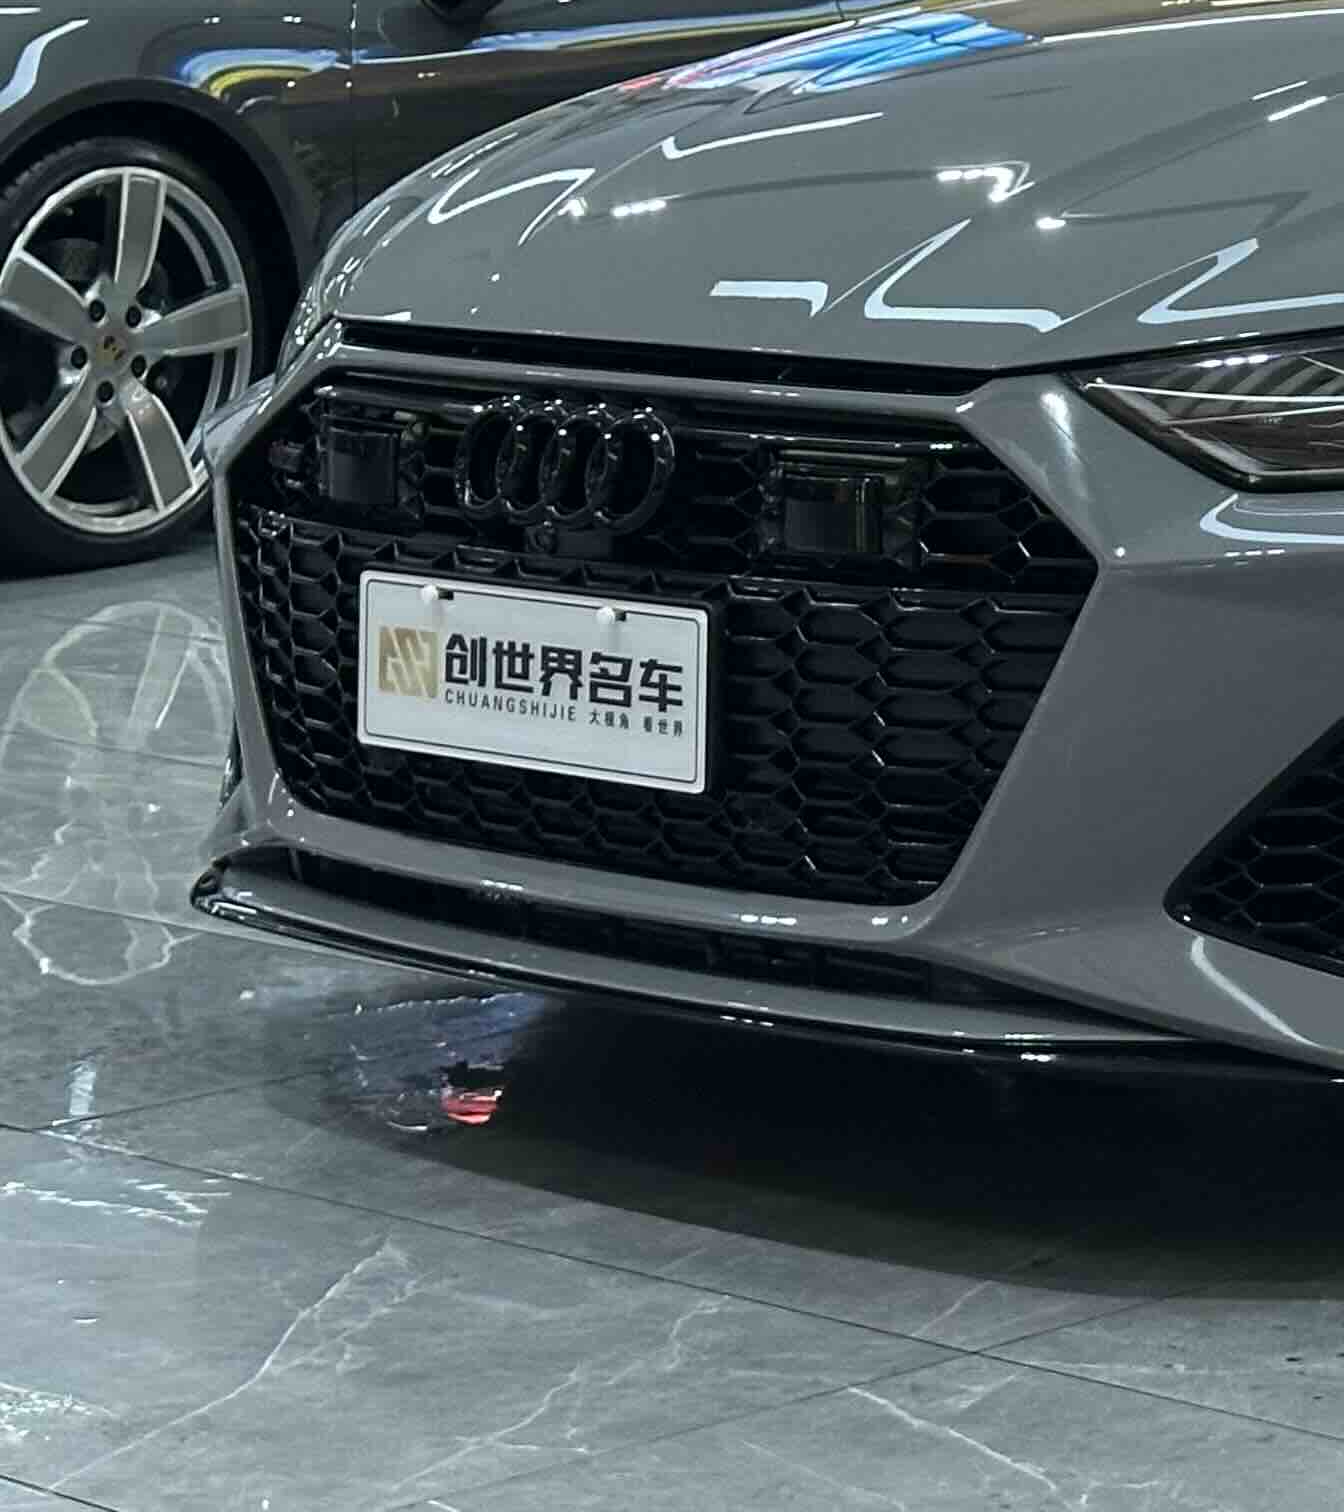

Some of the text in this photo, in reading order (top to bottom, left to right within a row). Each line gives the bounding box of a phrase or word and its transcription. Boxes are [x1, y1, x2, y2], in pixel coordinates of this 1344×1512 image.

[444, 633, 684, 713] 创世界名车
[445, 689, 577, 722] CHUANGSHIJIE
